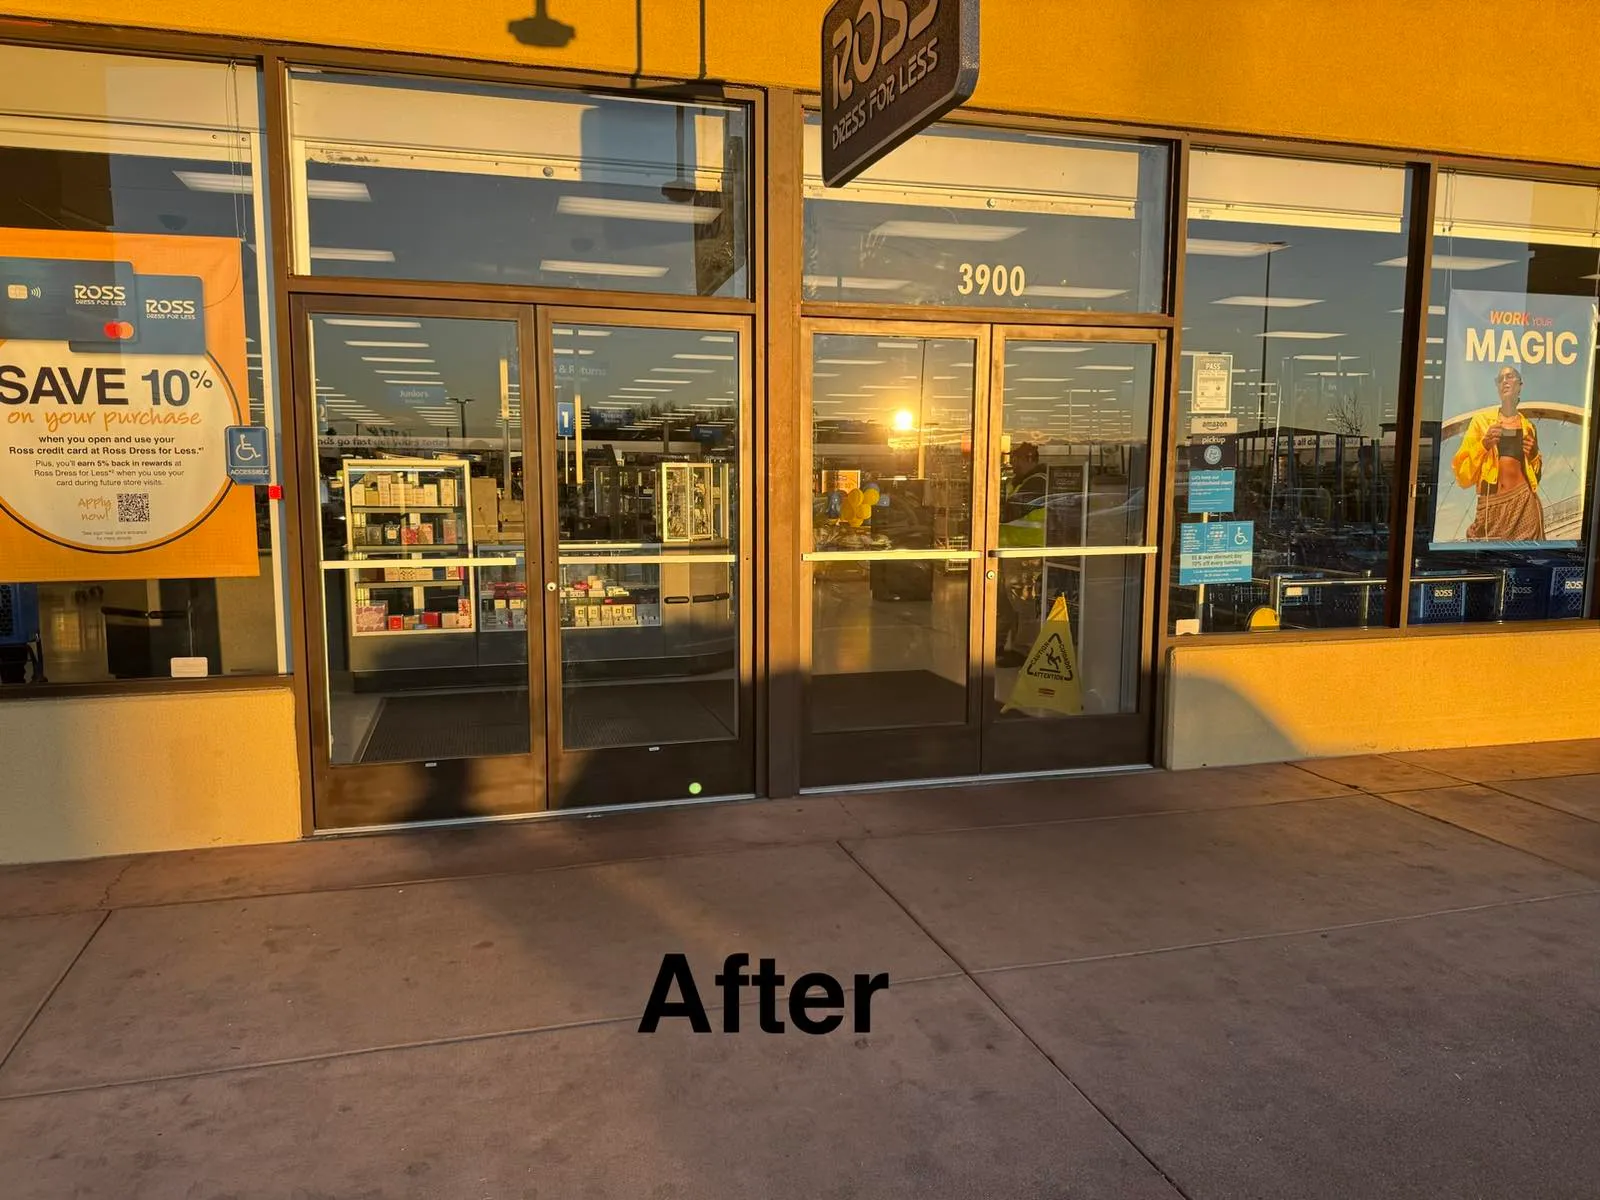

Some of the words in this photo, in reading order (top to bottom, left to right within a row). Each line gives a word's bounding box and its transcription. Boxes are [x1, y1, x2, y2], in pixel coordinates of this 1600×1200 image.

[832, 100, 866, 150] DRESS
[869, 74, 895, 118] FOR
[899, 37, 939, 95] LESS
[958, 263, 1026, 297] 3900
[74, 285, 126, 300] ROSS
[145, 299, 196, 314] ROSS
[1490, 311, 1528, 325] WORK
[1533, 318, 1552, 326] YOUR
[1466, 328, 1578, 365] MAGIC
[559, 364, 566, 374] &
[568, 365, 606, 376] Rturns
[0, 365, 129, 405] SAVE
[141, 369, 213, 407] 10%
[400, 390, 429, 398] Juniors
[7, 411, 34, 424] on
[45, 411, 96, 432] your
[103, 408, 202, 432] purchase
[562, 411, 569, 428] 1
[1202, 421, 1228, 430] amazon
[67, 437, 85, 445] you
[87, 437, 111, 445] open
[154, 437, 175, 445] your
[1202, 436, 1226, 445] pickup
[56, 460, 76, 468] you'll
[138, 470, 152, 478] you
[74, 480, 99, 488] during
[78, 496, 112, 510] Apply
[81, 508, 109, 520] now!
[1031, 642, 1049, 665] CAUTION
[1059, 641, 1071, 670] CUIDADO
[1033, 671, 1063, 680] ATTENTION
